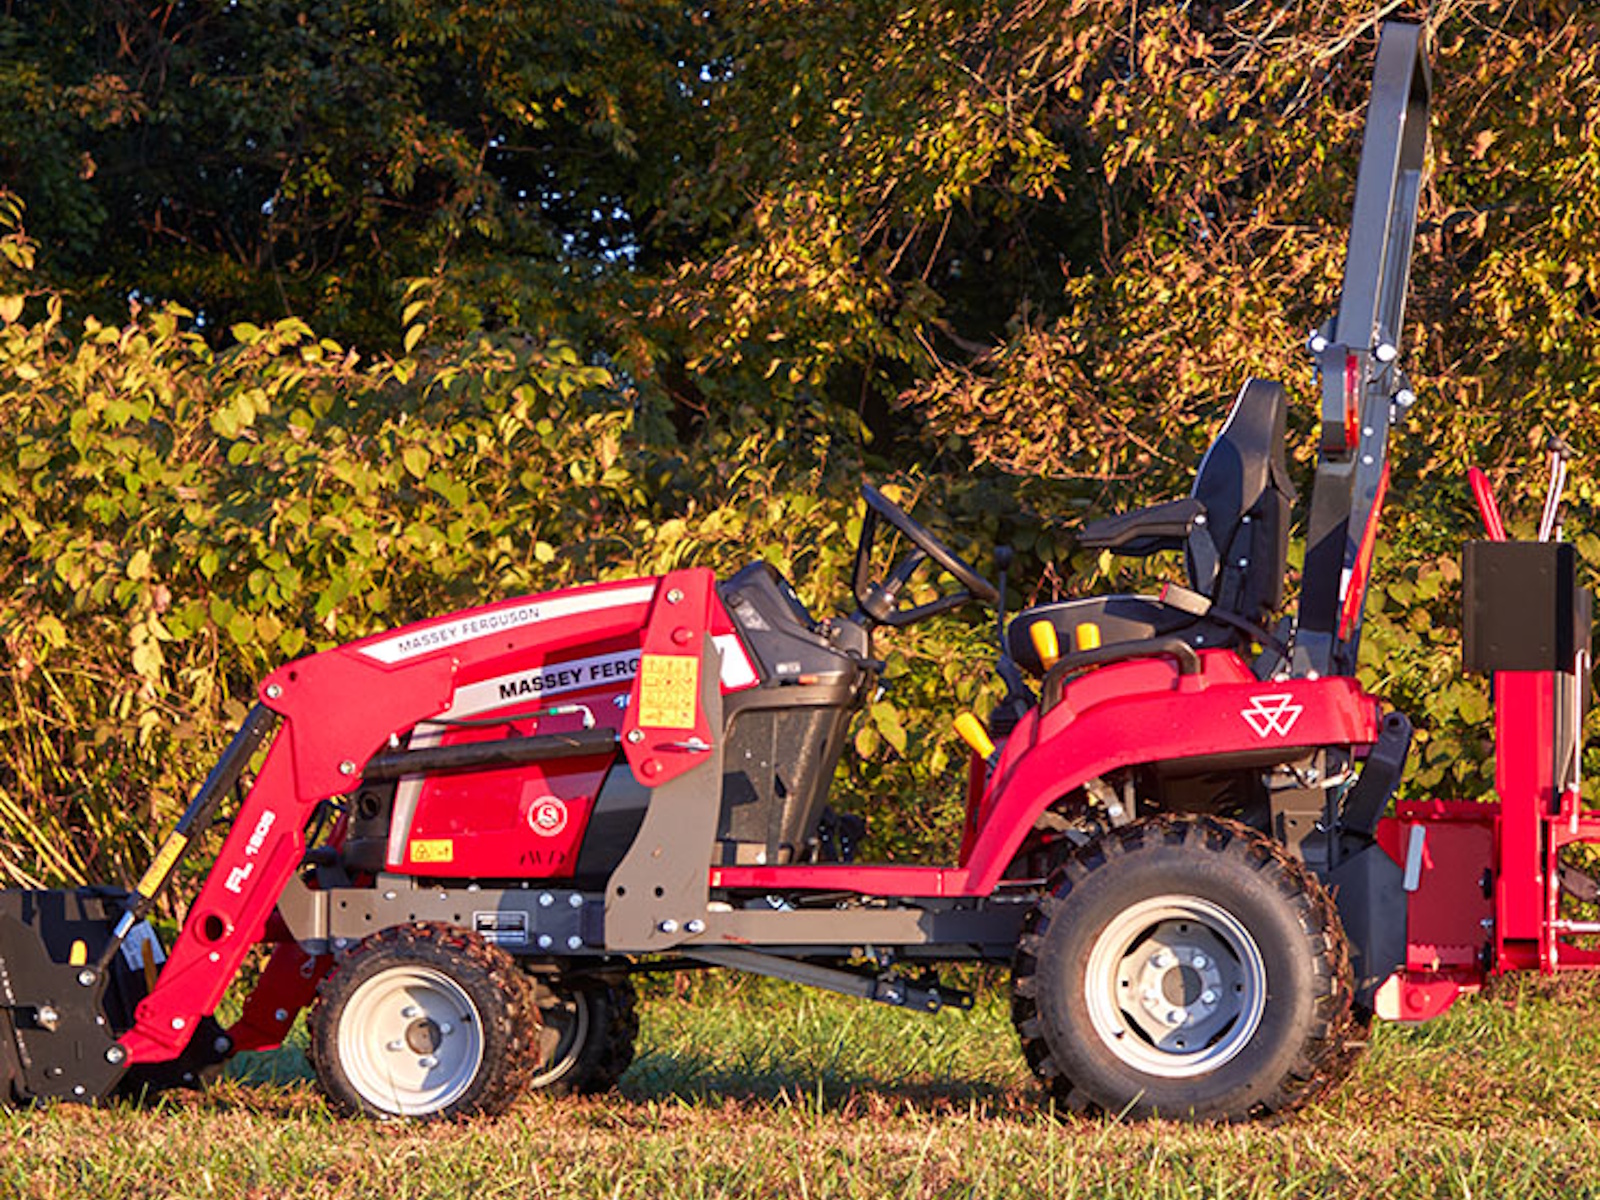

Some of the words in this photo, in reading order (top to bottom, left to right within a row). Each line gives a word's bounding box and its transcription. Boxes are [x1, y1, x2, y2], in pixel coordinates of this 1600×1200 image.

[398, 627, 457, 652] MASSEY
[462, 608, 540, 635] FERGUSON
[499, 667, 583, 699] MASSEY
[224, 862, 254, 893] FL
